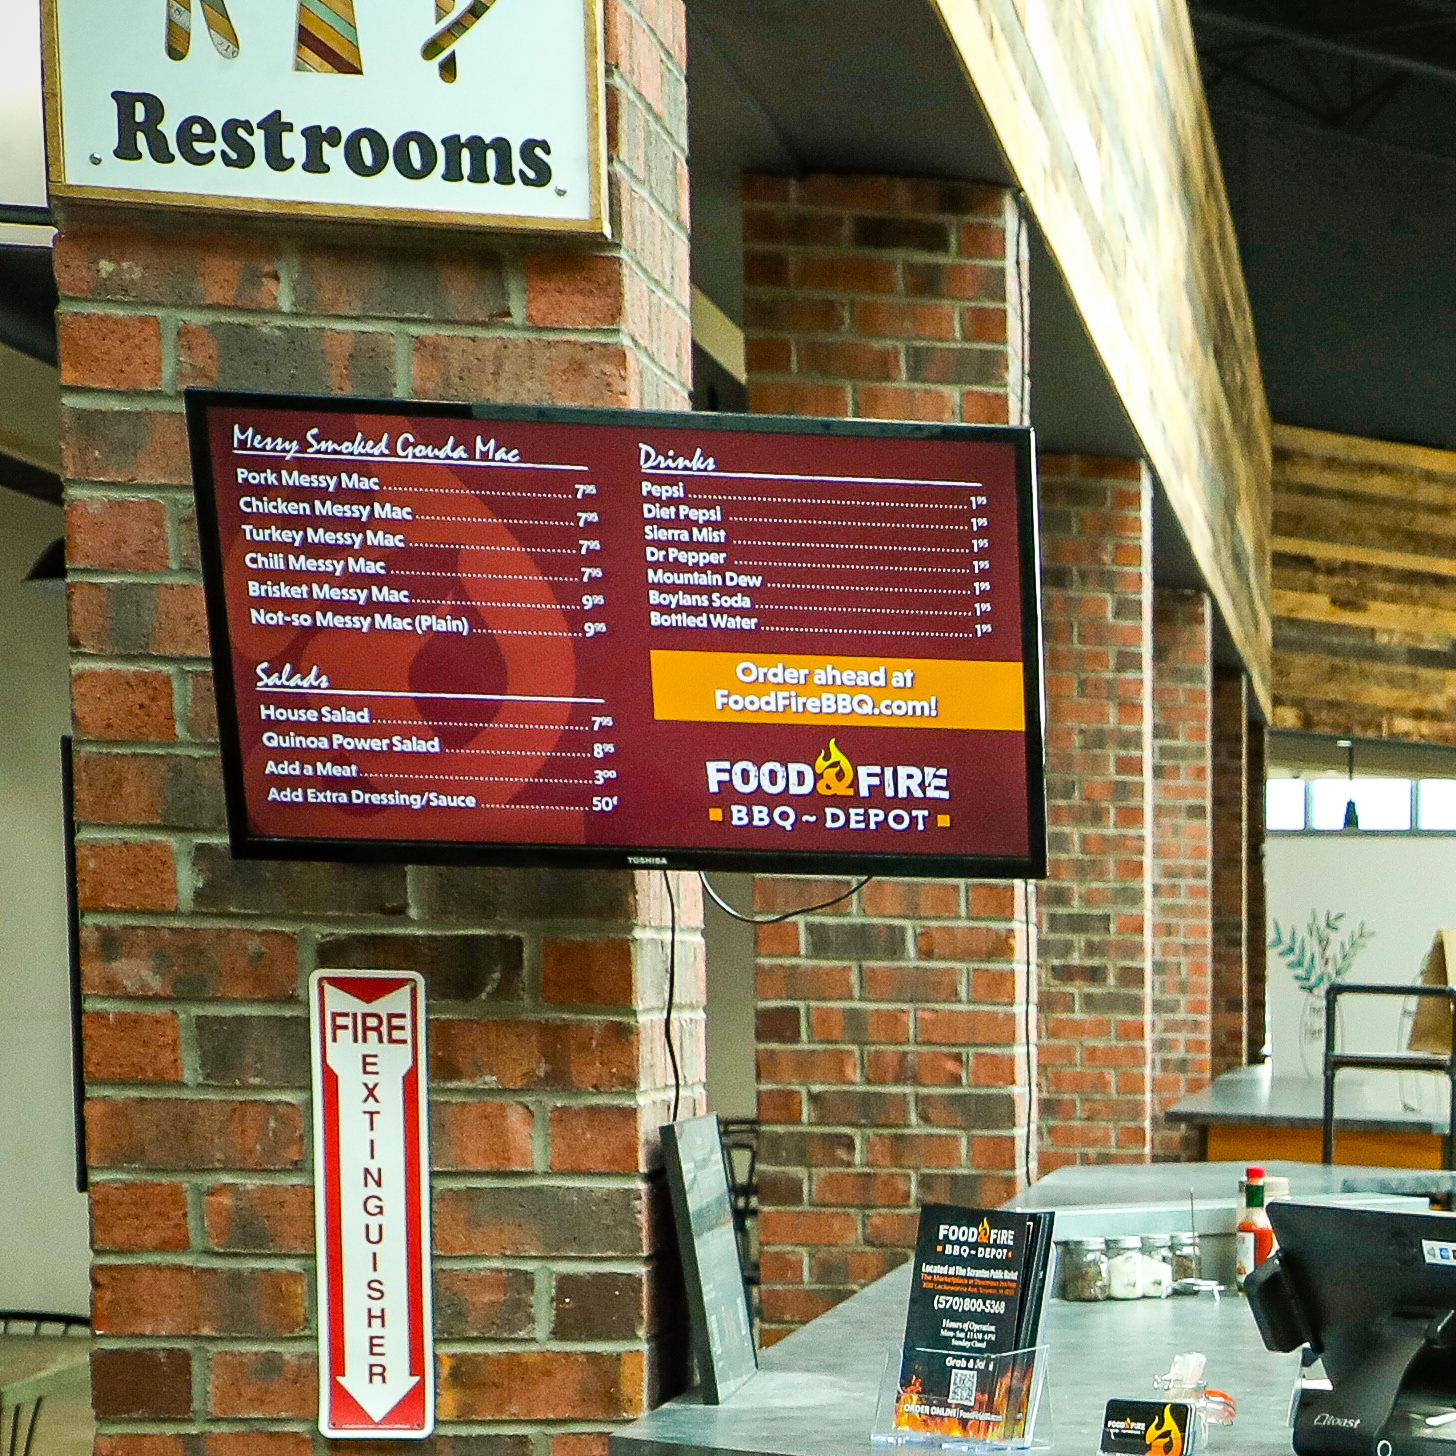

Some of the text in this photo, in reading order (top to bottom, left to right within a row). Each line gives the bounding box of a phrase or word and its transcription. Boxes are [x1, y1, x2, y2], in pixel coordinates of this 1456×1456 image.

[111, 91, 552, 188] Restrooms
[233, 424, 521, 463] Messy Smoked Gouda Mac
[639, 443, 716, 471] Drinks
[237, 468, 278, 486] Pork
[282, 472, 337, 491] Messy
[341, 474, 380, 491] Mac
[641, 481, 684, 500] Pepsi
[239, 497, 311, 516] Chicken
[315, 502, 370, 520] Messy
[374, 503, 412, 520] Mac
[643, 504, 676, 520] Diet
[679, 505, 721, 523] Pepsi
[242, 524, 303, 545] Turkey
[307, 529, 362, 548] Messy
[367, 530, 404, 547] Mac
[644, 525, 689, 542] Sierra
[693, 526, 726, 543] Mist
[245, 552, 284, 570] Chili
[289, 556, 344, 576] Messy
[349, 558, 386, 574] Mac
[646, 547, 664, 563] Dr
[668, 549, 726, 567] Pepper
[647, 569, 722, 586] Mountain
[726, 571, 762, 588] Dew
[248, 581, 308, 600] Brisket
[312, 586, 367, 604] Messy
[371, 587, 410, 603] Mac
[649, 590, 708, 610] Boylans
[711, 592, 752, 609] Soda
[250, 608, 312, 628] Not-so
[317, 614, 371, 632] Messy
[375, 614, 413, 631] Mac
[415, 614, 469, 635] (Plain)
[650, 612, 708, 630] Bottled
[710, 614, 758, 631] Water
[255, 662, 330, 689] Salads
[736, 661, 914, 689] Order ahead at
[260, 705, 318, 723] House
[322, 707, 370, 724] Salad
[715, 690, 938, 717] FoodFireBBQ.com!
[262, 732, 329, 751] Quinoa
[333, 735, 390, 752] Power
[393, 736, 441, 753] Salad
[265, 760, 301, 776] Add
[303, 765, 313, 776] a
[317, 762, 358, 777] Meat
[705, 761, 814, 795] FOOD
[857, 766, 951, 800] FIRE
[268, 787, 303, 802] Add
[307, 789, 347, 804] Extra
[351, 790, 476, 809] Dressing/Sauce
[730, 805, 795, 831] BBQ
[824, 807, 929, 831] DEPOT
[627, 856, 667, 865] TOSHIBA
[331, 1011, 408, 1045] FIRE
[361, 1053, 387, 1385] EXTINGUISHER
[938, 1224, 978, 1242] FOOD
[990, 1229, 1015, 1245] FIRE
[945, 1244, 1008, 1259] BBQ DEPOT
[922, 1263, 948, 1274] Located
[946, 1357, 966, 1367] Grab
[904, 1404, 929, 1415] ORDER
